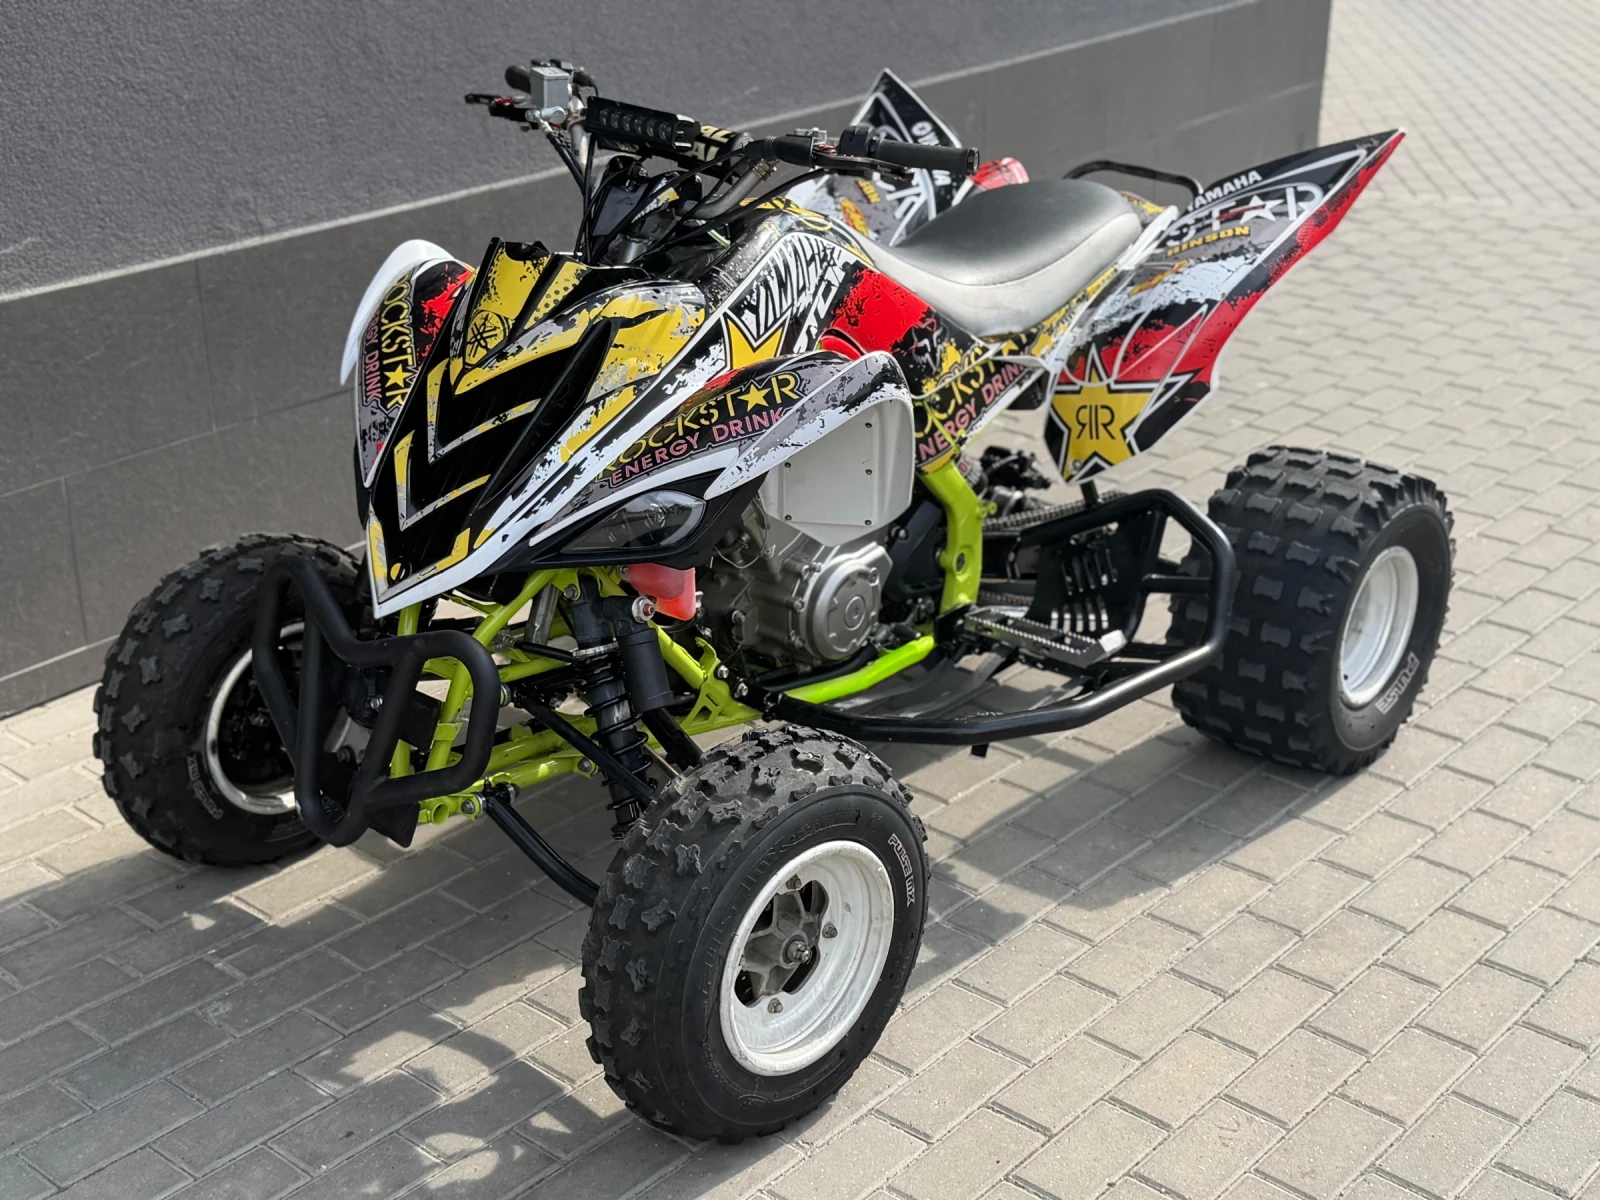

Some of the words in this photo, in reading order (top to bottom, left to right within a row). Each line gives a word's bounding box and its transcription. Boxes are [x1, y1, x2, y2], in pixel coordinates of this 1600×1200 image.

[1187, 170, 1263, 212] AMAHA
[365, 350, 382, 399] DRINK
[918, 398, 977, 460] NERGY
[981, 363, 1025, 404] DRIN
[611, 431, 700, 485] ENERGY
[712, 406, 784, 442] DRINK
[1374, 651, 1420, 714] PULSE
[887, 832, 913, 878] PULSE
